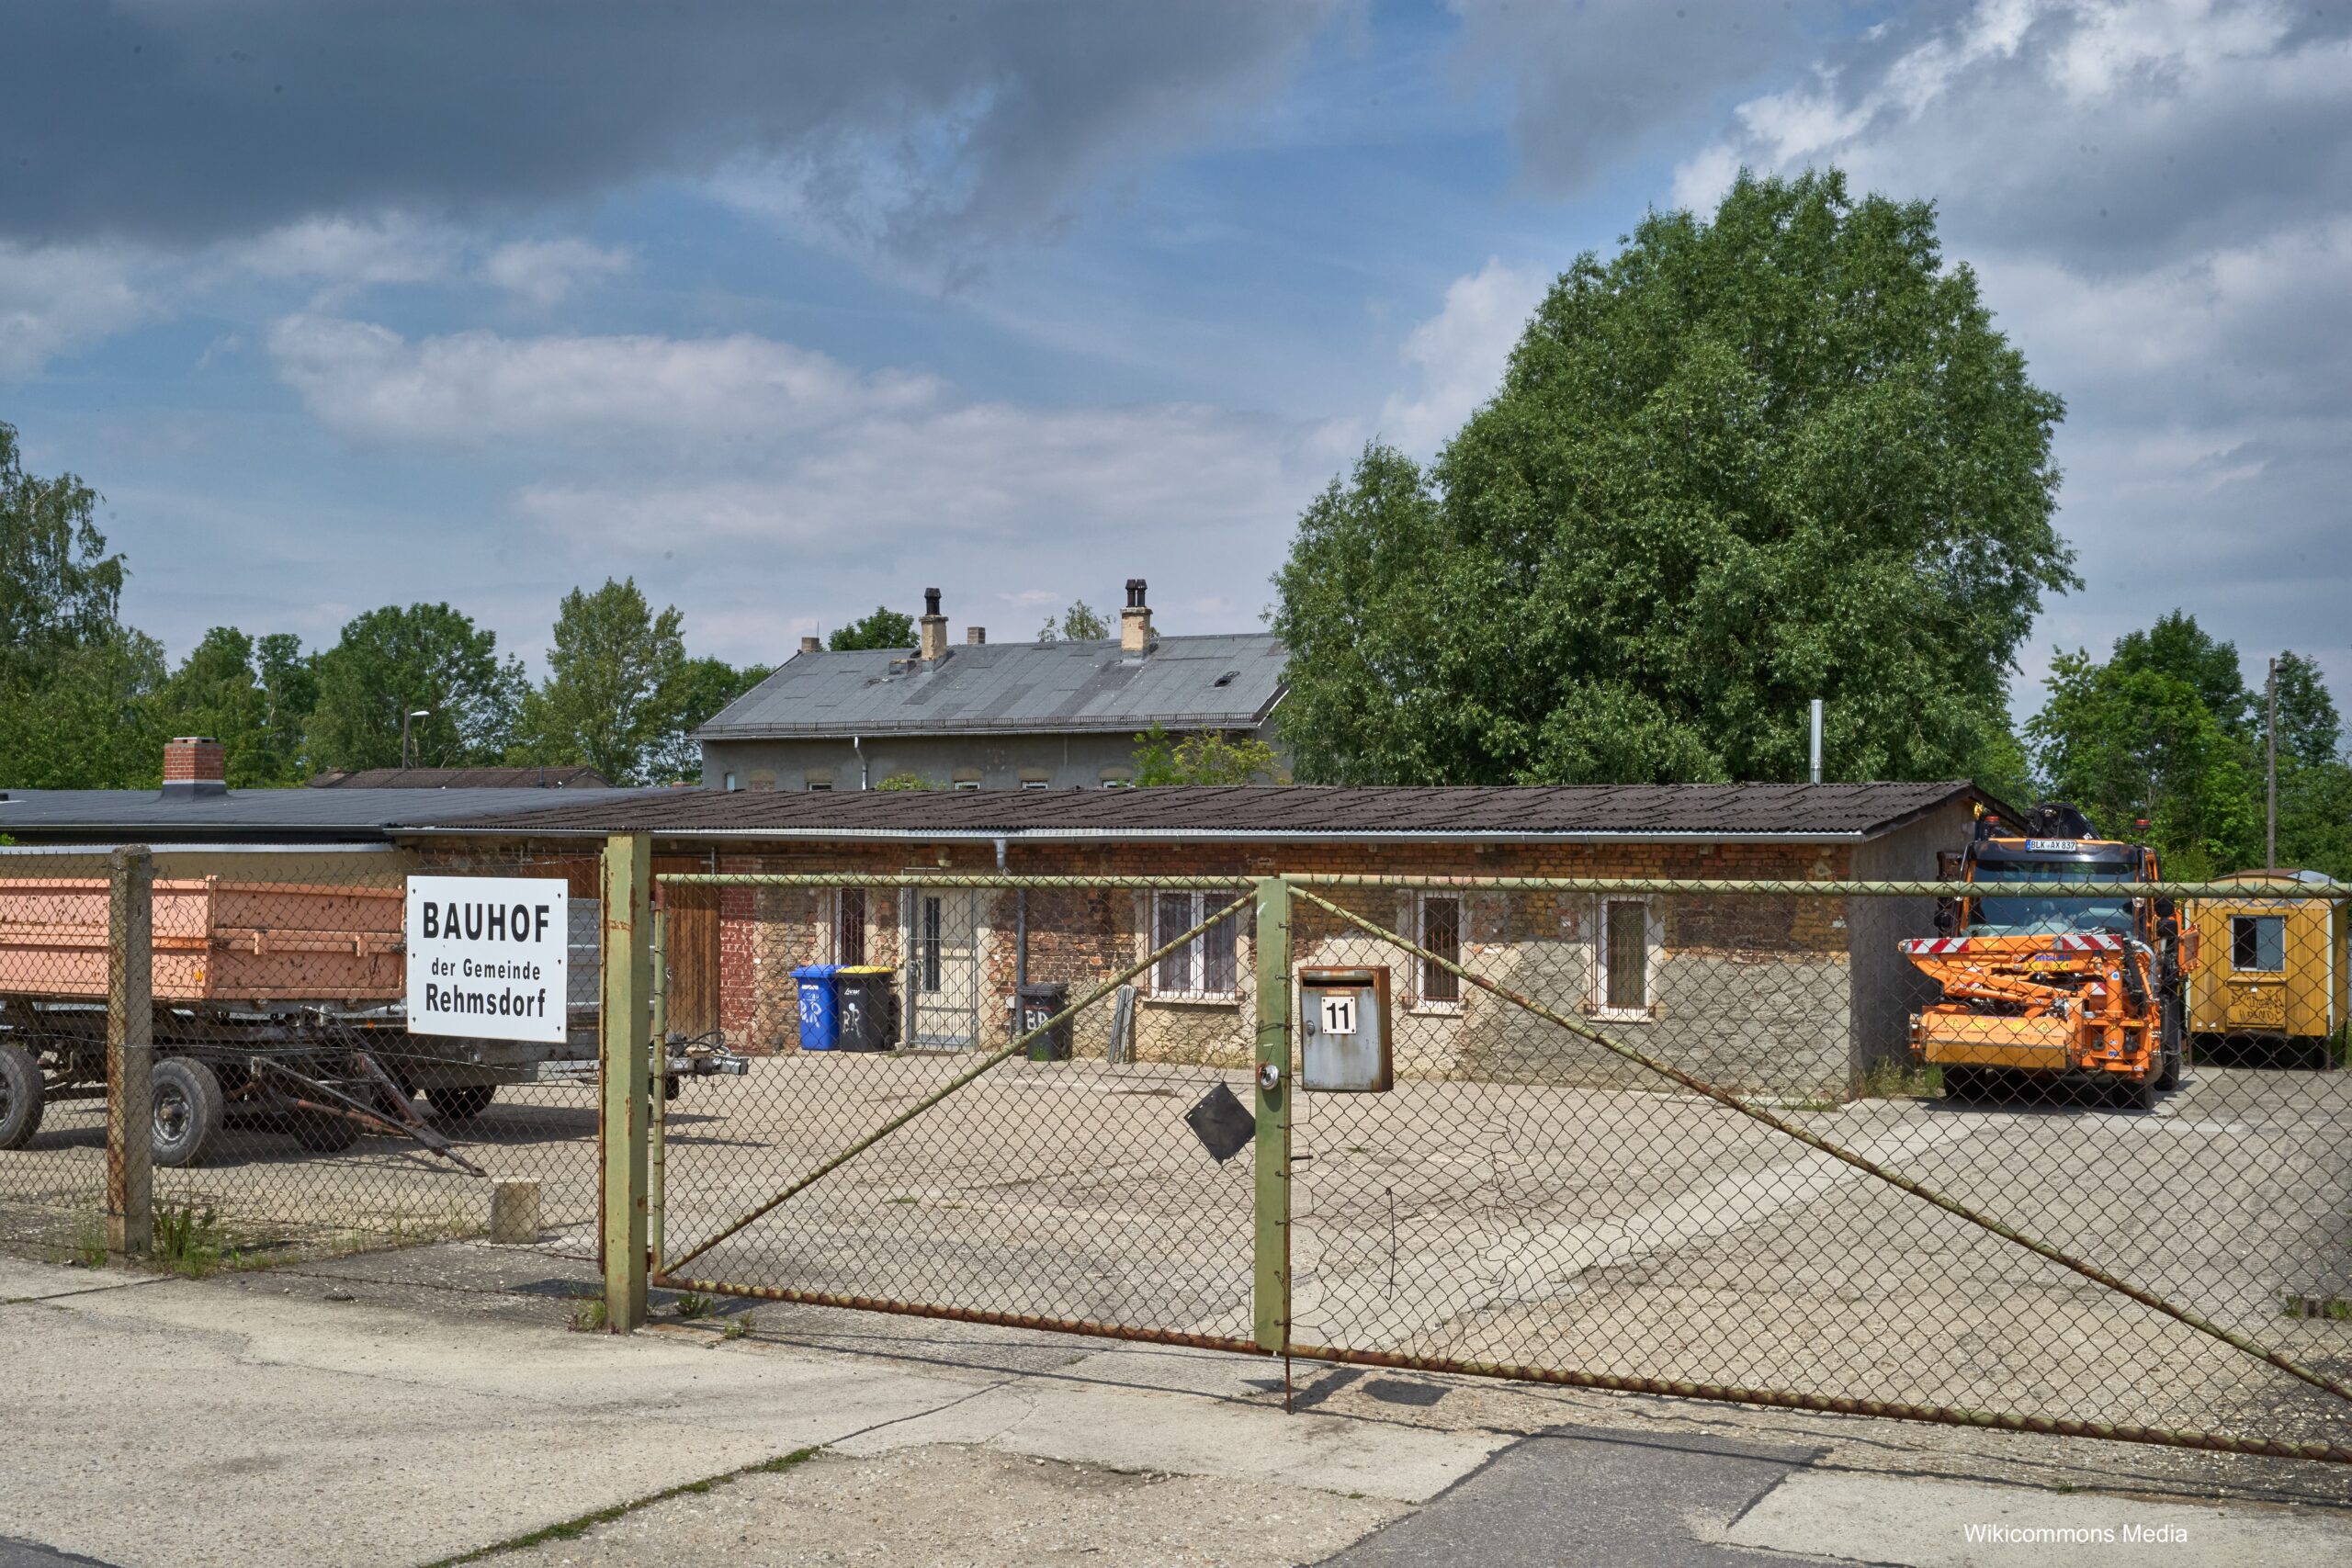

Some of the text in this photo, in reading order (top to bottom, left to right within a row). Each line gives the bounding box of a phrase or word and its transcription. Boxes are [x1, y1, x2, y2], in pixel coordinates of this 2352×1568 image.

[2030, 840, 2075, 850] BLK AX 837
[423, 901, 550, 943] BAUHOF
[431, 957, 541, 981] der Gemeinde
[425, 983, 547, 1018] Rehmsdorf
[1326, 1002, 1350, 1030] 11
